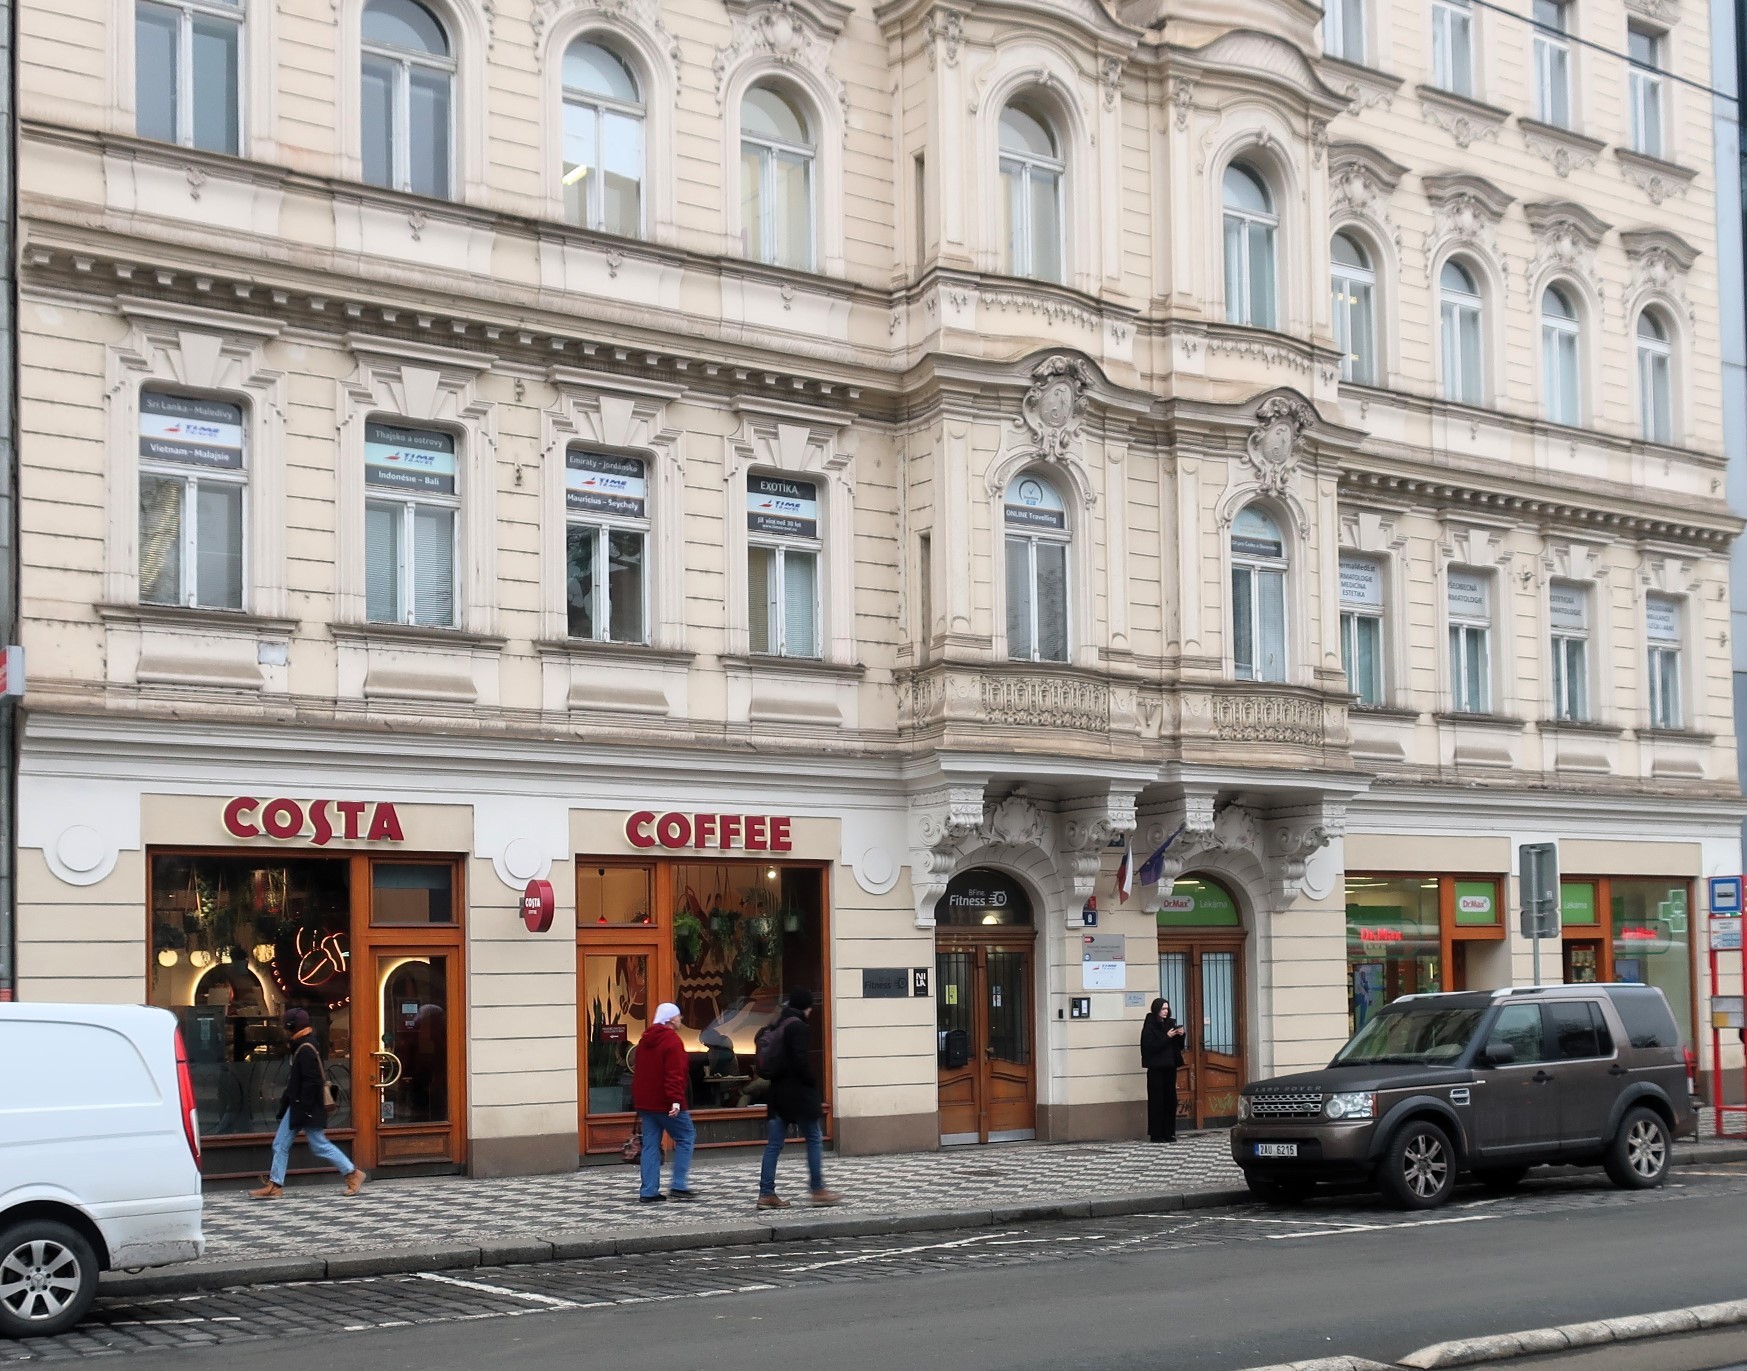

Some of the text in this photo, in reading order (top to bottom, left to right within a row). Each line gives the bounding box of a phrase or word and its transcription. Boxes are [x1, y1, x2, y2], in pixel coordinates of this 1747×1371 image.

[147, 399, 159, 408] Sri
[161, 400, 187, 413] Lanka
[194, 407, 233, 421] Maledivy
[375, 430, 406, 442] Thajsko
[413, 437, 443, 449] ostrovy
[150, 443, 187, 456] Vietnam
[194, 449, 230, 463] Malajsie
[403, 452, 435, 462] TIME
[378, 470, 417, 483] Indonésie
[424, 477, 440, 486] Bali
[599, 478, 628, 486] TIME
[760, 480, 799, 494] EXOTIKA
[567, 494, 602, 505] Mauricius
[607, 498, 638, 512] Seychely
[775, 500, 801, 509] TIME
[1006, 509, 1057, 524] ONLINE Travelling
[1342, 588, 1366, 598] ESTETIKA
[223, 796, 405, 846] COSTA
[625, 810, 793, 852] COFFEE
[525, 897, 541, 909] COSTA
[949, 894, 986, 907] Fitness
[1087, 913, 1093, 923] 8
[1360, 927, 1403, 942] Dr.Max
[865, 979, 892, 990] Fitness
[1255, 1085, 1322, 1094] LAND ROVER
[1260, 1145, 1295, 1155] 2AU 6215
